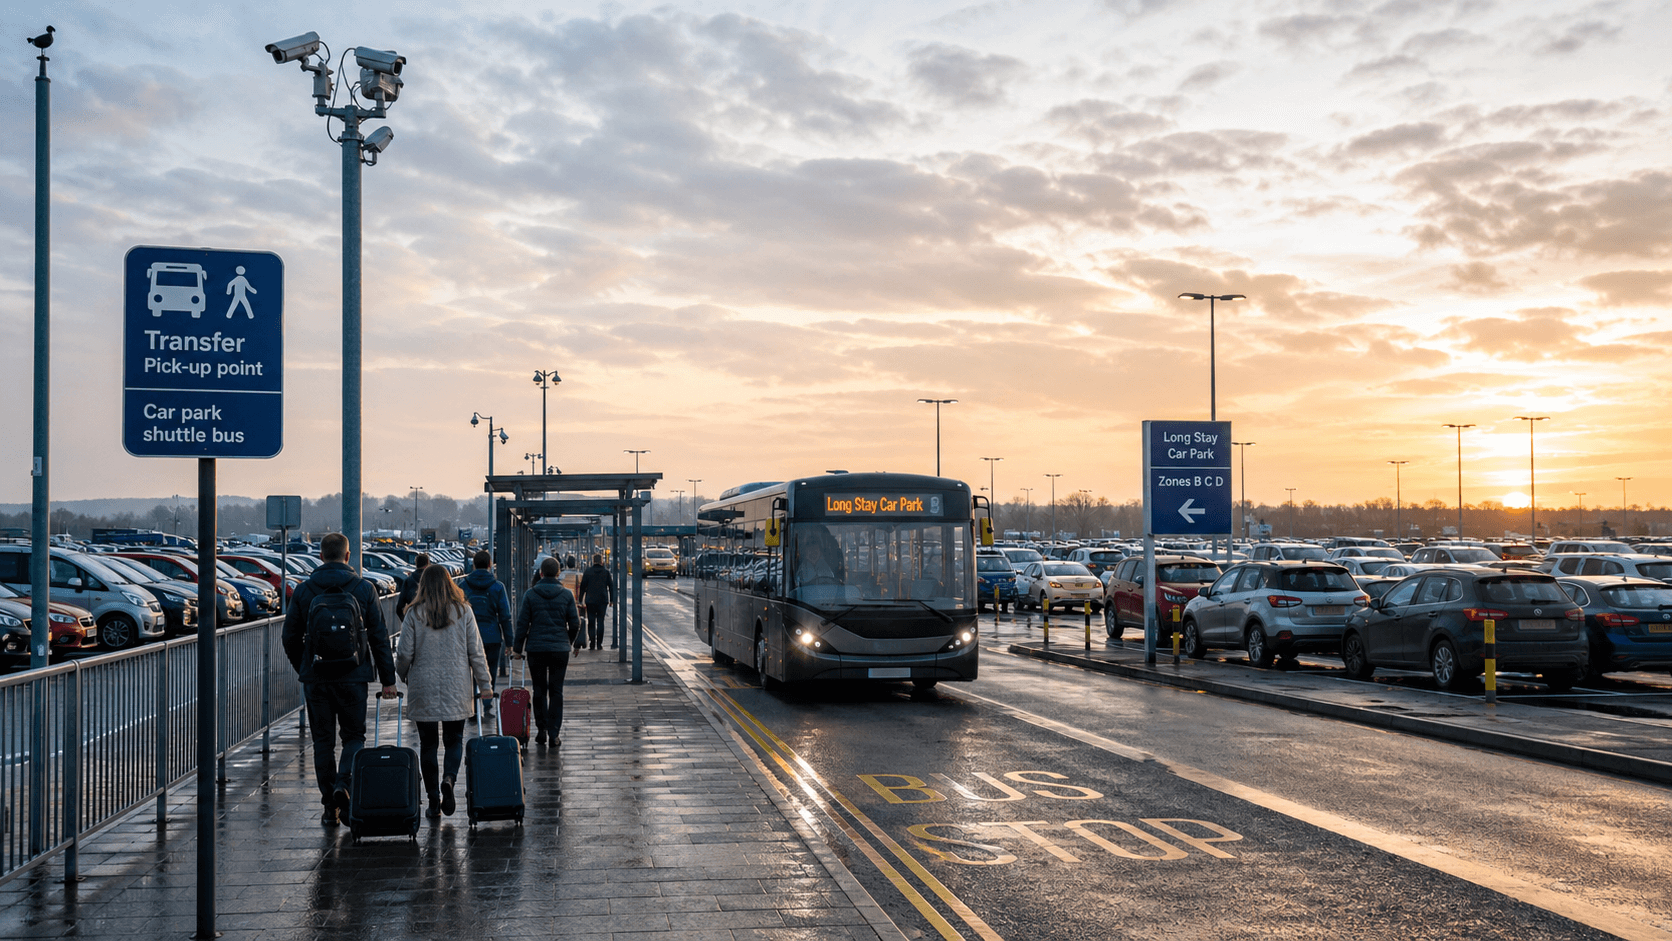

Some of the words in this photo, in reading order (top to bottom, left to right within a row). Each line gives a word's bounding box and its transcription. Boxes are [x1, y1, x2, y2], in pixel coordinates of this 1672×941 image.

[144, 330, 245, 353] Transfer
[144, 357, 212, 378] Pick-up
[217, 360, 263, 379] point
[143, 403, 176, 420] Car
[181, 404, 222, 423] park
[143, 426, 207, 443] shuttle
[212, 428, 245, 443] bus
[1163, 431, 1191, 445] Long
[1193, 431, 1218, 445] Stay
[1168, 448, 1188, 459] Car
[1190, 448, 1215, 459] Park
[1158, 475, 1191, 487] Zones
[1194, 476, 1202, 487] B
[1204, 476, 1213, 487] C
[1215, 476, 1224, 487] D
[827, 496, 853, 514] Long
[854, 496, 878, 514] Stay
[879, 496, 898, 512] Car
[899, 496, 924, 512] Park
[856, 770, 1104, 804] BUS
[906, 817, 1244, 866] STOP
